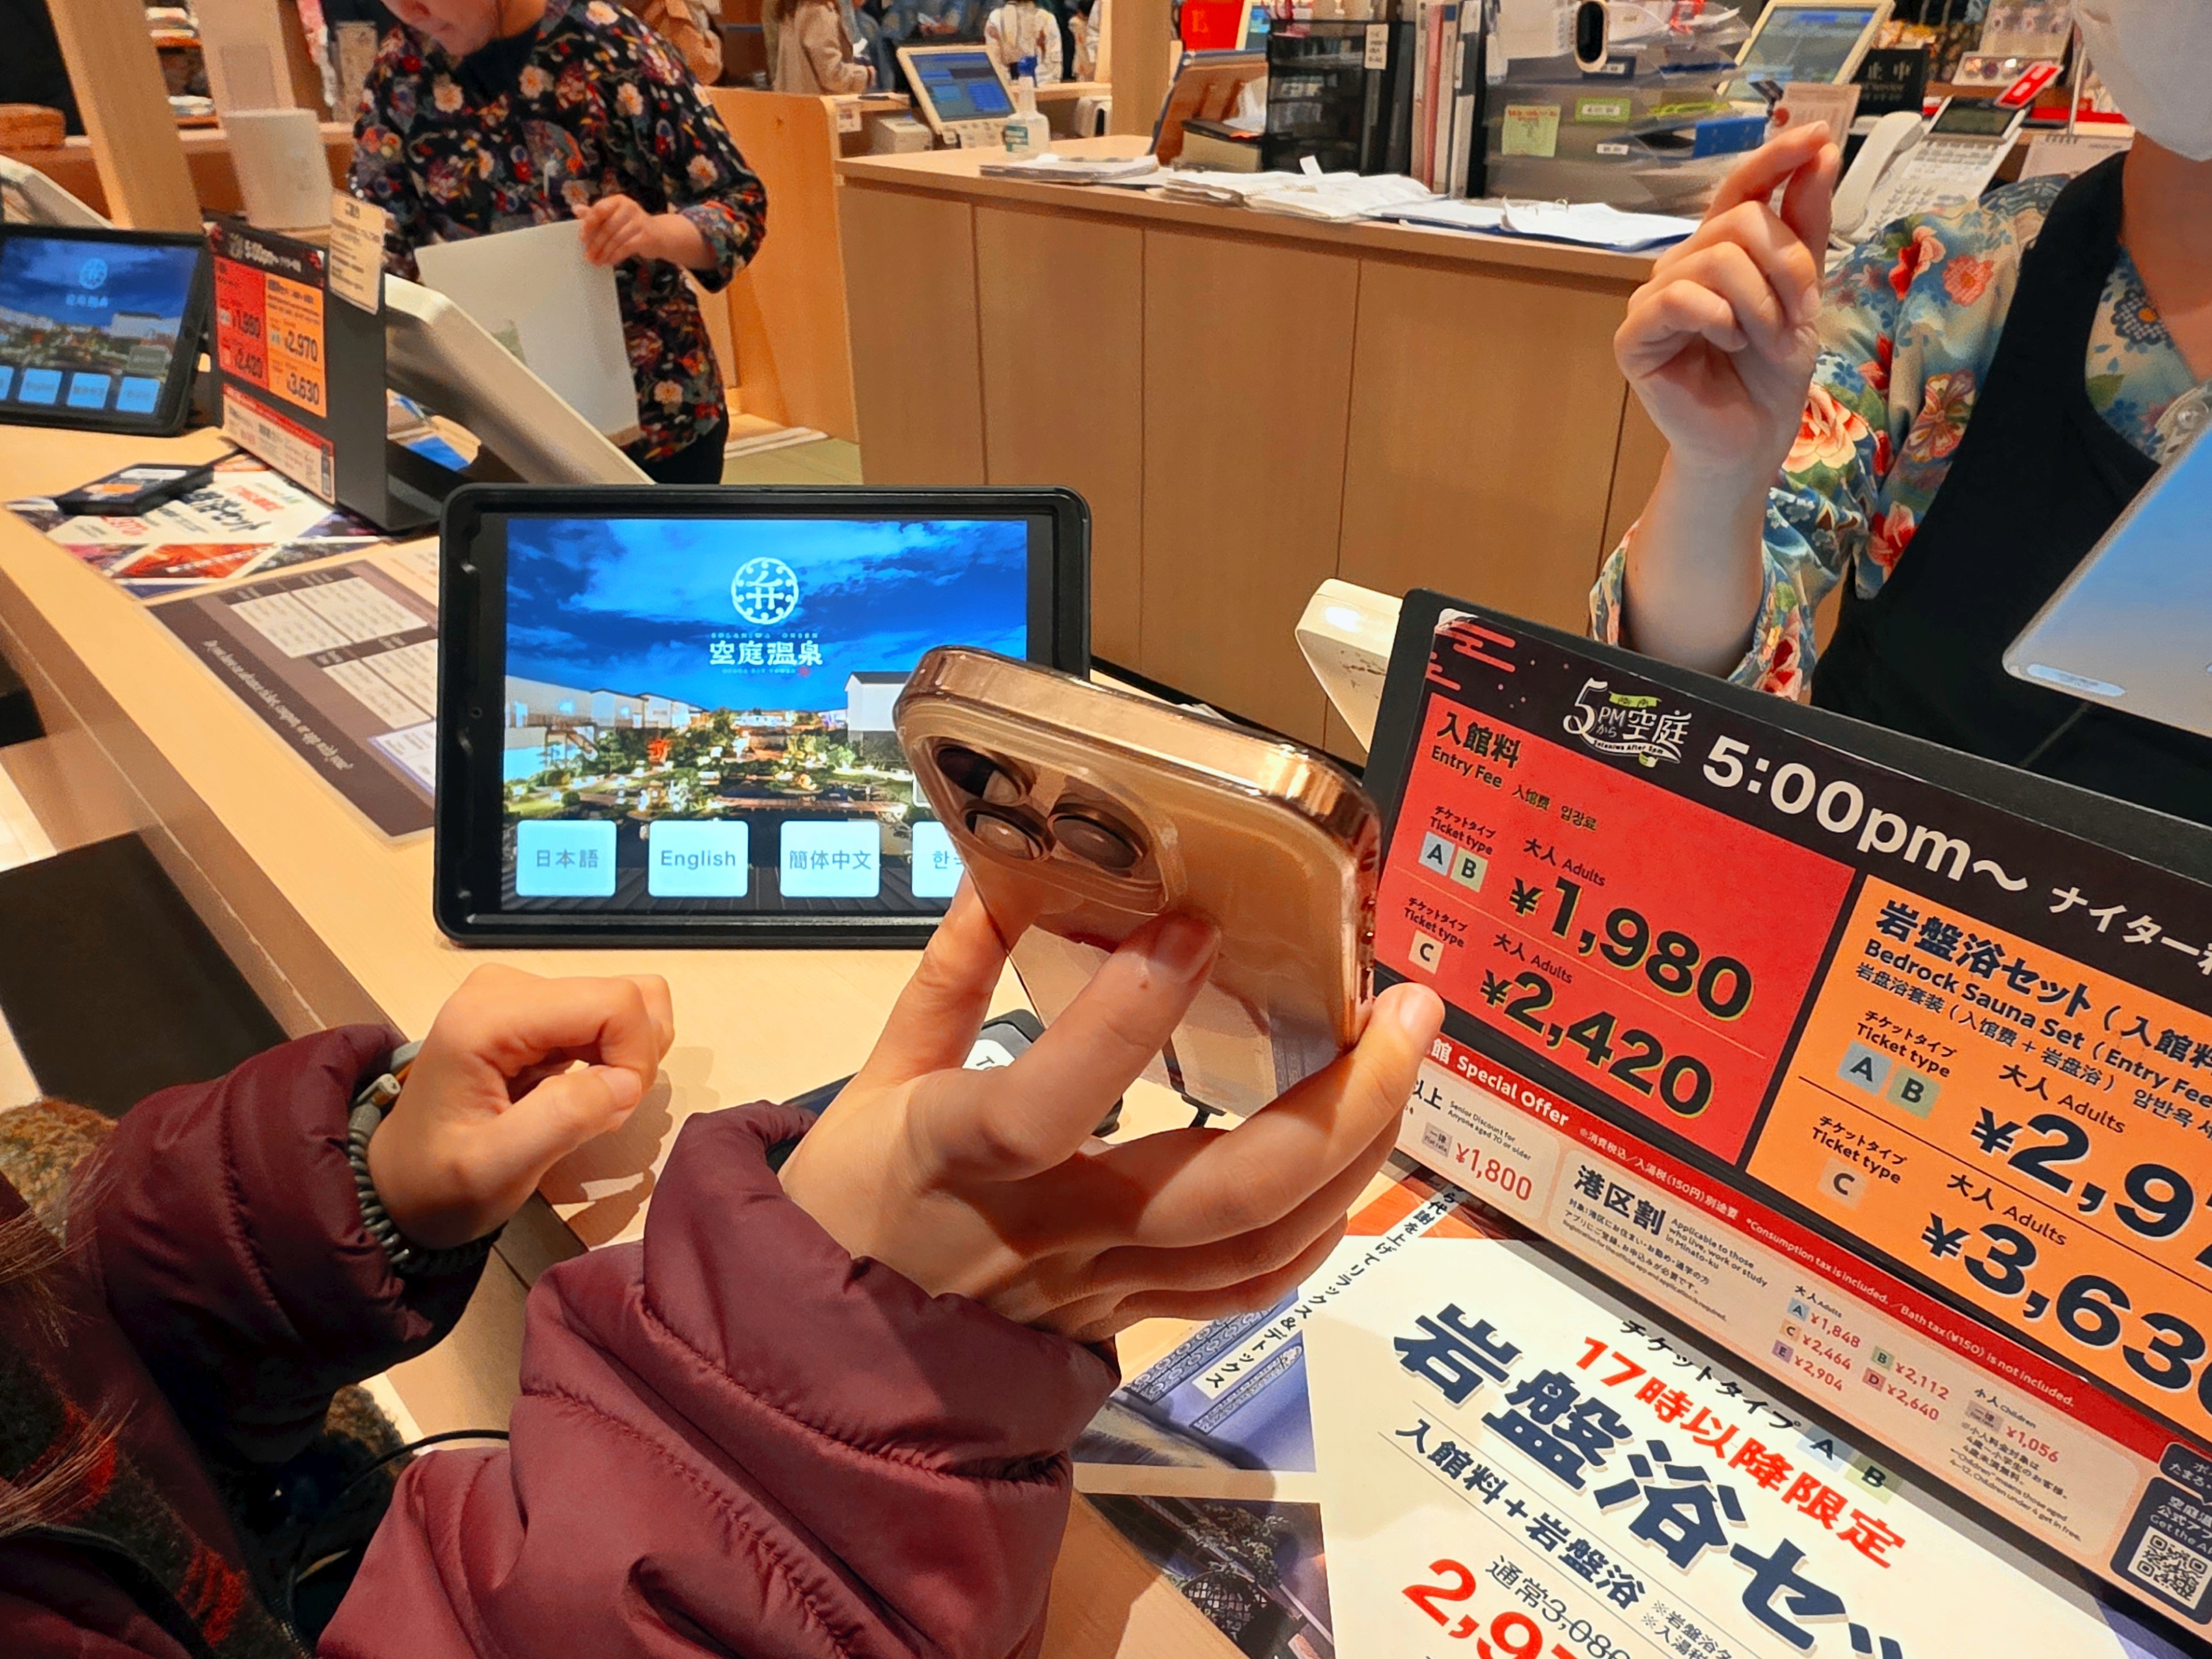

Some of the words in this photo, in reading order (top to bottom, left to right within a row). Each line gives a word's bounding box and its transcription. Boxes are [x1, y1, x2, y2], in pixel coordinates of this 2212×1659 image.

[710, 640, 823, 665] 空庭温泉
[1437, 711, 1522, 769] 入館料
[1598, 706, 1627, 727] PM
[1622, 709, 1692, 757] 空庭
[1431, 745, 1471, 778] Entry
[1474, 765, 1502, 789] Fee
[1430, 816, 1465, 841] Ticket
[1466, 835, 1493, 855] type
[1434, 805, 1497, 839] チケットタイプ
[1560, 805, 1597, 831] 입장료
[536, 850, 599, 868] 日本語
[661, 849, 736, 870] English
[789, 850, 872, 870] 簡体中文
[1427, 843, 1443, 865] A
[1461, 857, 1477, 879] B
[1522, 837, 1556, 866] 大人
[1562, 858, 1606, 887] Adults
[1404, 907, 1438, 934] Ticket
[1439, 924, 1465, 949] type
[1407, 896, 1468, 933] チケットタイプ
[1420, 942, 1435, 961] C
[1493, 933, 1525, 963] 大人
[1530, 955, 1573, 984] Adults
[1509, 876, 1753, 1022] ¥1,980
[1479, 968, 1714, 1119] ¥2,420
[1864, 938, 1960, 994] Bedrock
[1961, 981, 2036, 1029] Sauna
[2039, 1018, 2085, 1050] Set
[2172, 1078, 2212, 1108] Fee
[1865, 1010, 1957, 1059] チケットタイプ
[1857, 1022, 1907, 1058] Ticket
[1908, 1049, 1951, 1078] type
[1457, 1055, 1517, 1099] Special
[1521, 1091, 1569, 1126] Offer
[1850, 1056, 1874, 1083] A
[1900, 1077, 1924, 1104] B
[1998, 1065, 2049, 1101] 大人
[2057, 1094, 2126, 1133] Adults
[1449, 1101, 1472, 1118] Senior
[1472, 1114, 1503, 1137] Discount
[1504, 1131, 1516, 1143] for
[2133, 1089, 2194, 1128] 암반욕
[1448, 1109, 1474, 1129] Anyone
[1474, 1123, 1492, 1139] aged
[1493, 1133, 1502, 1145] 70
[1503, 1142, 1512, 1150] or
[1512, 1145, 1532, 1161] older
[1812, 1127, 1862, 1166] Ticket
[1862, 1157, 1902, 1184] type
[1819, 1115, 1907, 1166] チケットタイプ
[1456, 1143, 1532, 1201] ¥1,800
[1834, 1172, 1855, 1195] C
[1970, 1107, 2212, 1267] ¥2,9
[1574, 1165, 1666, 1236] 港区割
[1946, 1173, 1994, 1211] 大人
[2002, 1205, 2067, 1247] Adults
[1666, 1234, 1674, 1244] in
[1675, 1240, 1719, 1270] Minato-ku
[1669, 1228, 1687, 1241] who
[1688, 1237, 1706, 1253] live,
[1707, 1249, 1730, 1266] work
[1731, 1263, 1741, 1271] or
[1742, 1269, 1768, 1287] study
[1671, 1218, 1717, 1248] Applicable
[1719, 1244, 1728, 1254] to
[1729, 1250, 1754, 1268] those
[1794, 1285, 1816, 1304] 大人
[1922, 1212, 2212, 1416] ¥3,63
[1792, 1305, 1803, 1316] A
[1810, 1313, 1861, 1349] ¥1,848
[1816, 1257, 1832, 1272] tax
[1832, 1267, 1842, 1277] is
[1842, 1272, 1888, 1305] included.
[1927, 1321, 1946, 1337] tax
[1987, 1353, 1997, 1365] is
[1998, 1360, 2020, 1376] not
[2020, 1370, 2074, 1407] included.
[1778, 1346, 1787, 1358] E
[1794, 1355, 1843, 1391] ¥2,904
[1868, 1374, 1880, 1385] D
[1887, 1384, 1940, 1421] ¥2,640
[1786, 1326, 1796, 1336] C
[1802, 1334, 1851, 1370] ¥2,464
[1877, 1353, 1888, 1365] B
[1895, 1362, 1949, 1400] ¥2,112
[1619, 1319, 1802, 1431] チケットタイプ
[1809, 1437, 1835, 1461] A
[1861, 1466, 1887, 1490] B
[1574, 1335, 1906, 1570] 17時以降限定
[2006, 1426, 2061, 1463] ¥1,056
[2006, 1493, 2032, 1510] under
[2053, 1520, 2062, 1529] in
[2022, 1491, 2046, 1509] those
[2150, 1514, 2173, 1533] Get
[2173, 1527, 2196, 1546] the
[1401, 1558, 1581, 1659] 2,9
